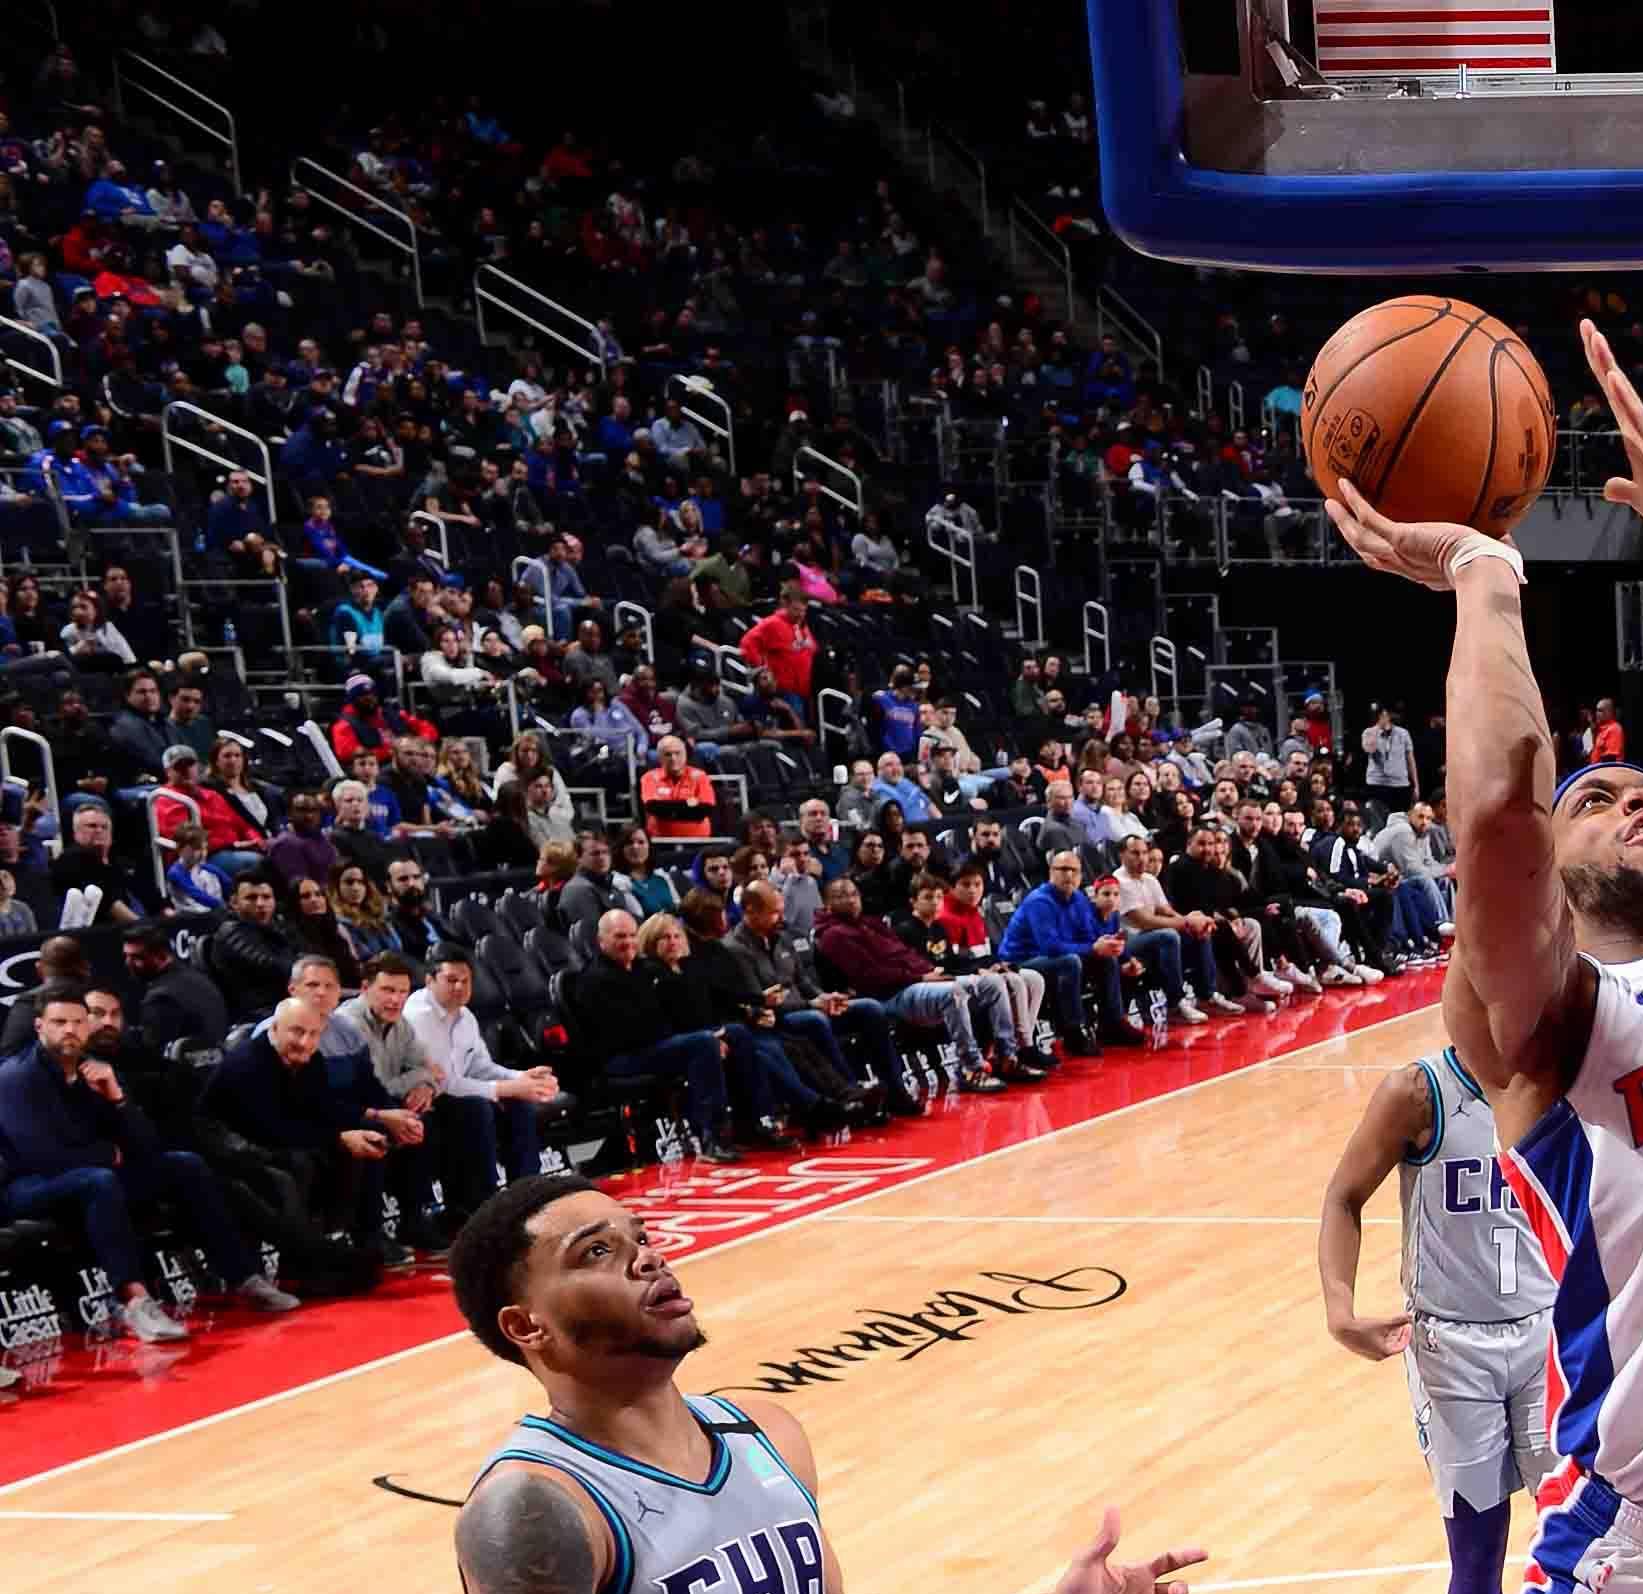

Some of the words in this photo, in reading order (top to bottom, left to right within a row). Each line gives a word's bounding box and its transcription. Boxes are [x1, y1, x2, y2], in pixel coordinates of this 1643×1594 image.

[1440, 1154, 1522, 1215] CH
[1492, 1226, 1518, 1296] 1
[0, 1313, 63, 1349] Caesar
